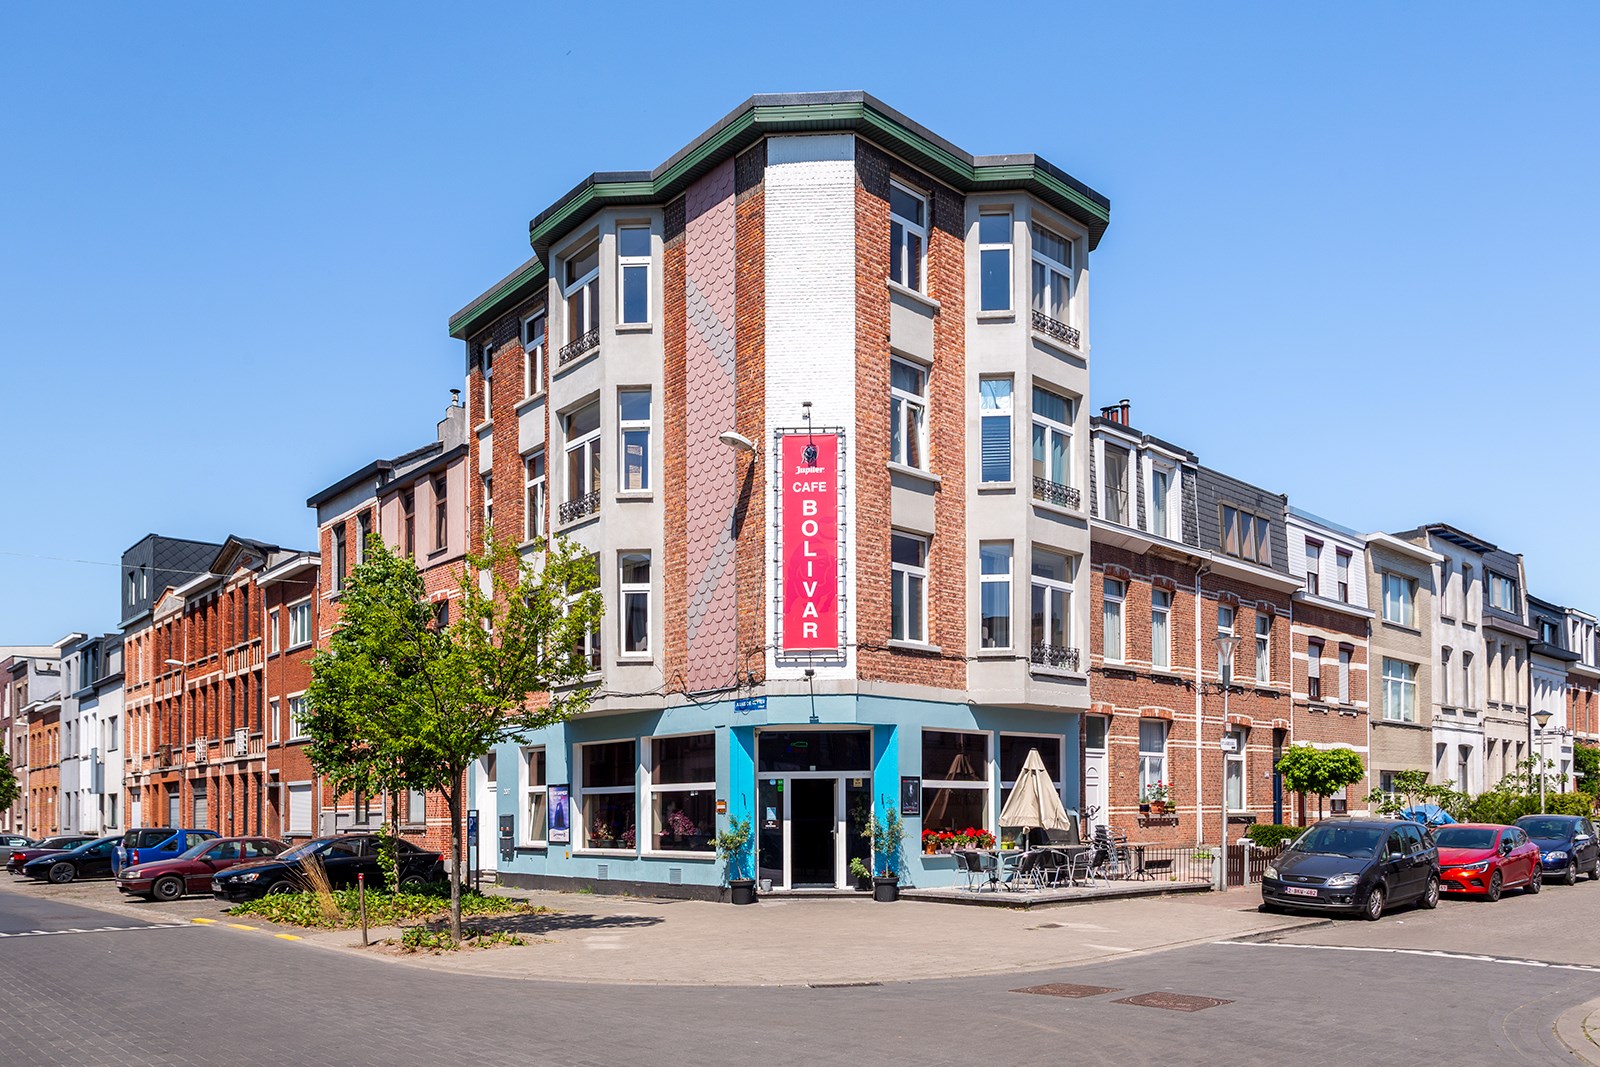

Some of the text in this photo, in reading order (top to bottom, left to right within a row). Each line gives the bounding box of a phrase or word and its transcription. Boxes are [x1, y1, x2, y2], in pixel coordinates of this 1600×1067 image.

[795, 466, 825, 475] Jupiler
[792, 481, 827, 493] CAFE
[801, 499, 818, 638] BOLIVAR
